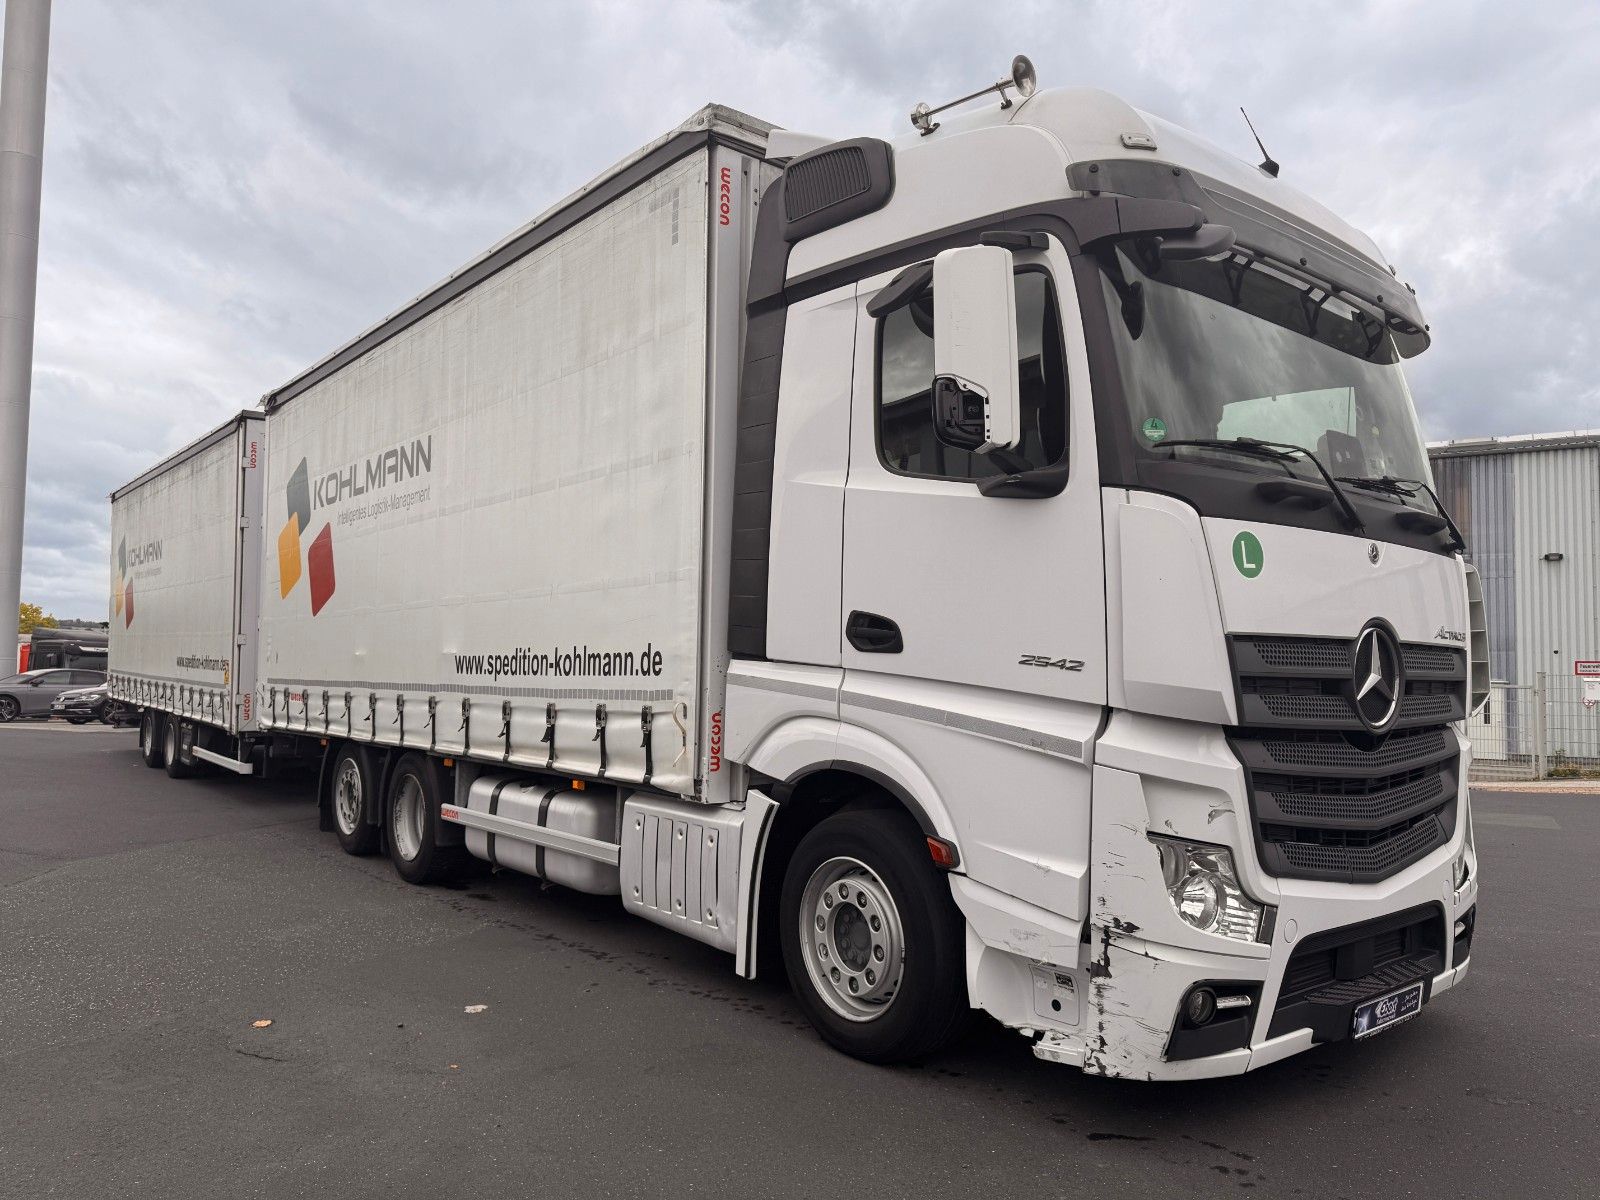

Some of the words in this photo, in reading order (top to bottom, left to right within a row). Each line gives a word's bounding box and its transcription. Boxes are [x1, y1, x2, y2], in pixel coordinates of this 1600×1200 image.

[720, 167, 730, 225] wecon
[313, 434, 432, 511] KOHLMANN
[1241, 540, 1256, 569] L
[455, 643, 663, 681] www.spedition-kohlmann.de
[1018, 654, 1085, 672] 2542
[709, 712, 721, 773] wecon
